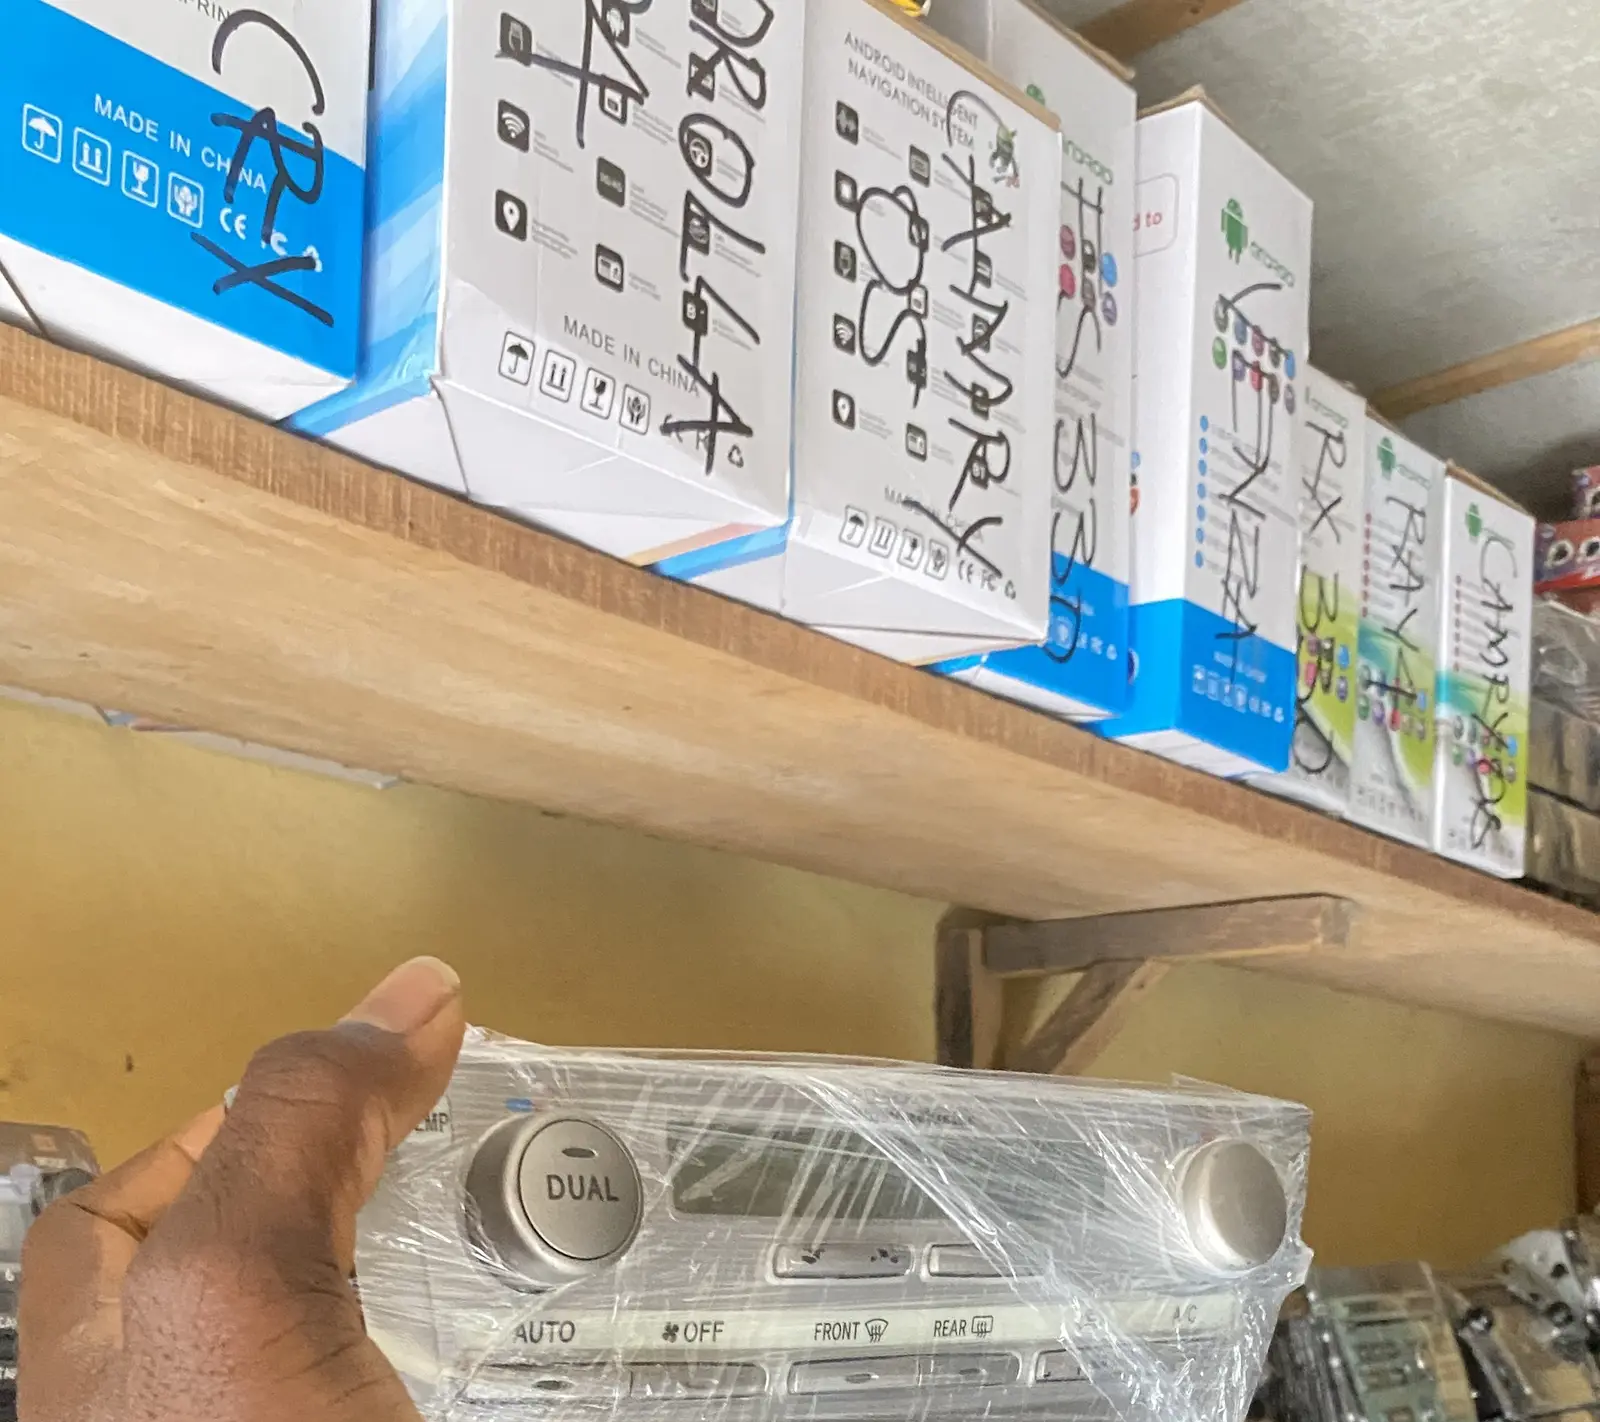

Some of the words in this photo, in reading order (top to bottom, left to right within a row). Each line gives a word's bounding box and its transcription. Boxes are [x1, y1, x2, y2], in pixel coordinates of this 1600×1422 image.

[844, 32, 906, 81] ANDROID
[847, 57, 929, 121] NAVIGATION
[931, 111, 975, 151] SYTEM
[94, 94, 159, 139] MADE
[169, 130, 191, 158] IN
[201, 146, 266, 195] CHNA
[563, 315, 615, 356] MADE
[623, 344, 642, 368] IN
[647, 358, 701, 398] CHINA
[1301, 421, 1347, 545] RX
[545, 1173, 620, 1203] DUAL
[515, 1319, 576, 1344] AUTO
[683, 1320, 725, 1343] OFF
[812, 1320, 861, 1342] FRONT
[932, 1317, 968, 1339] REAR
